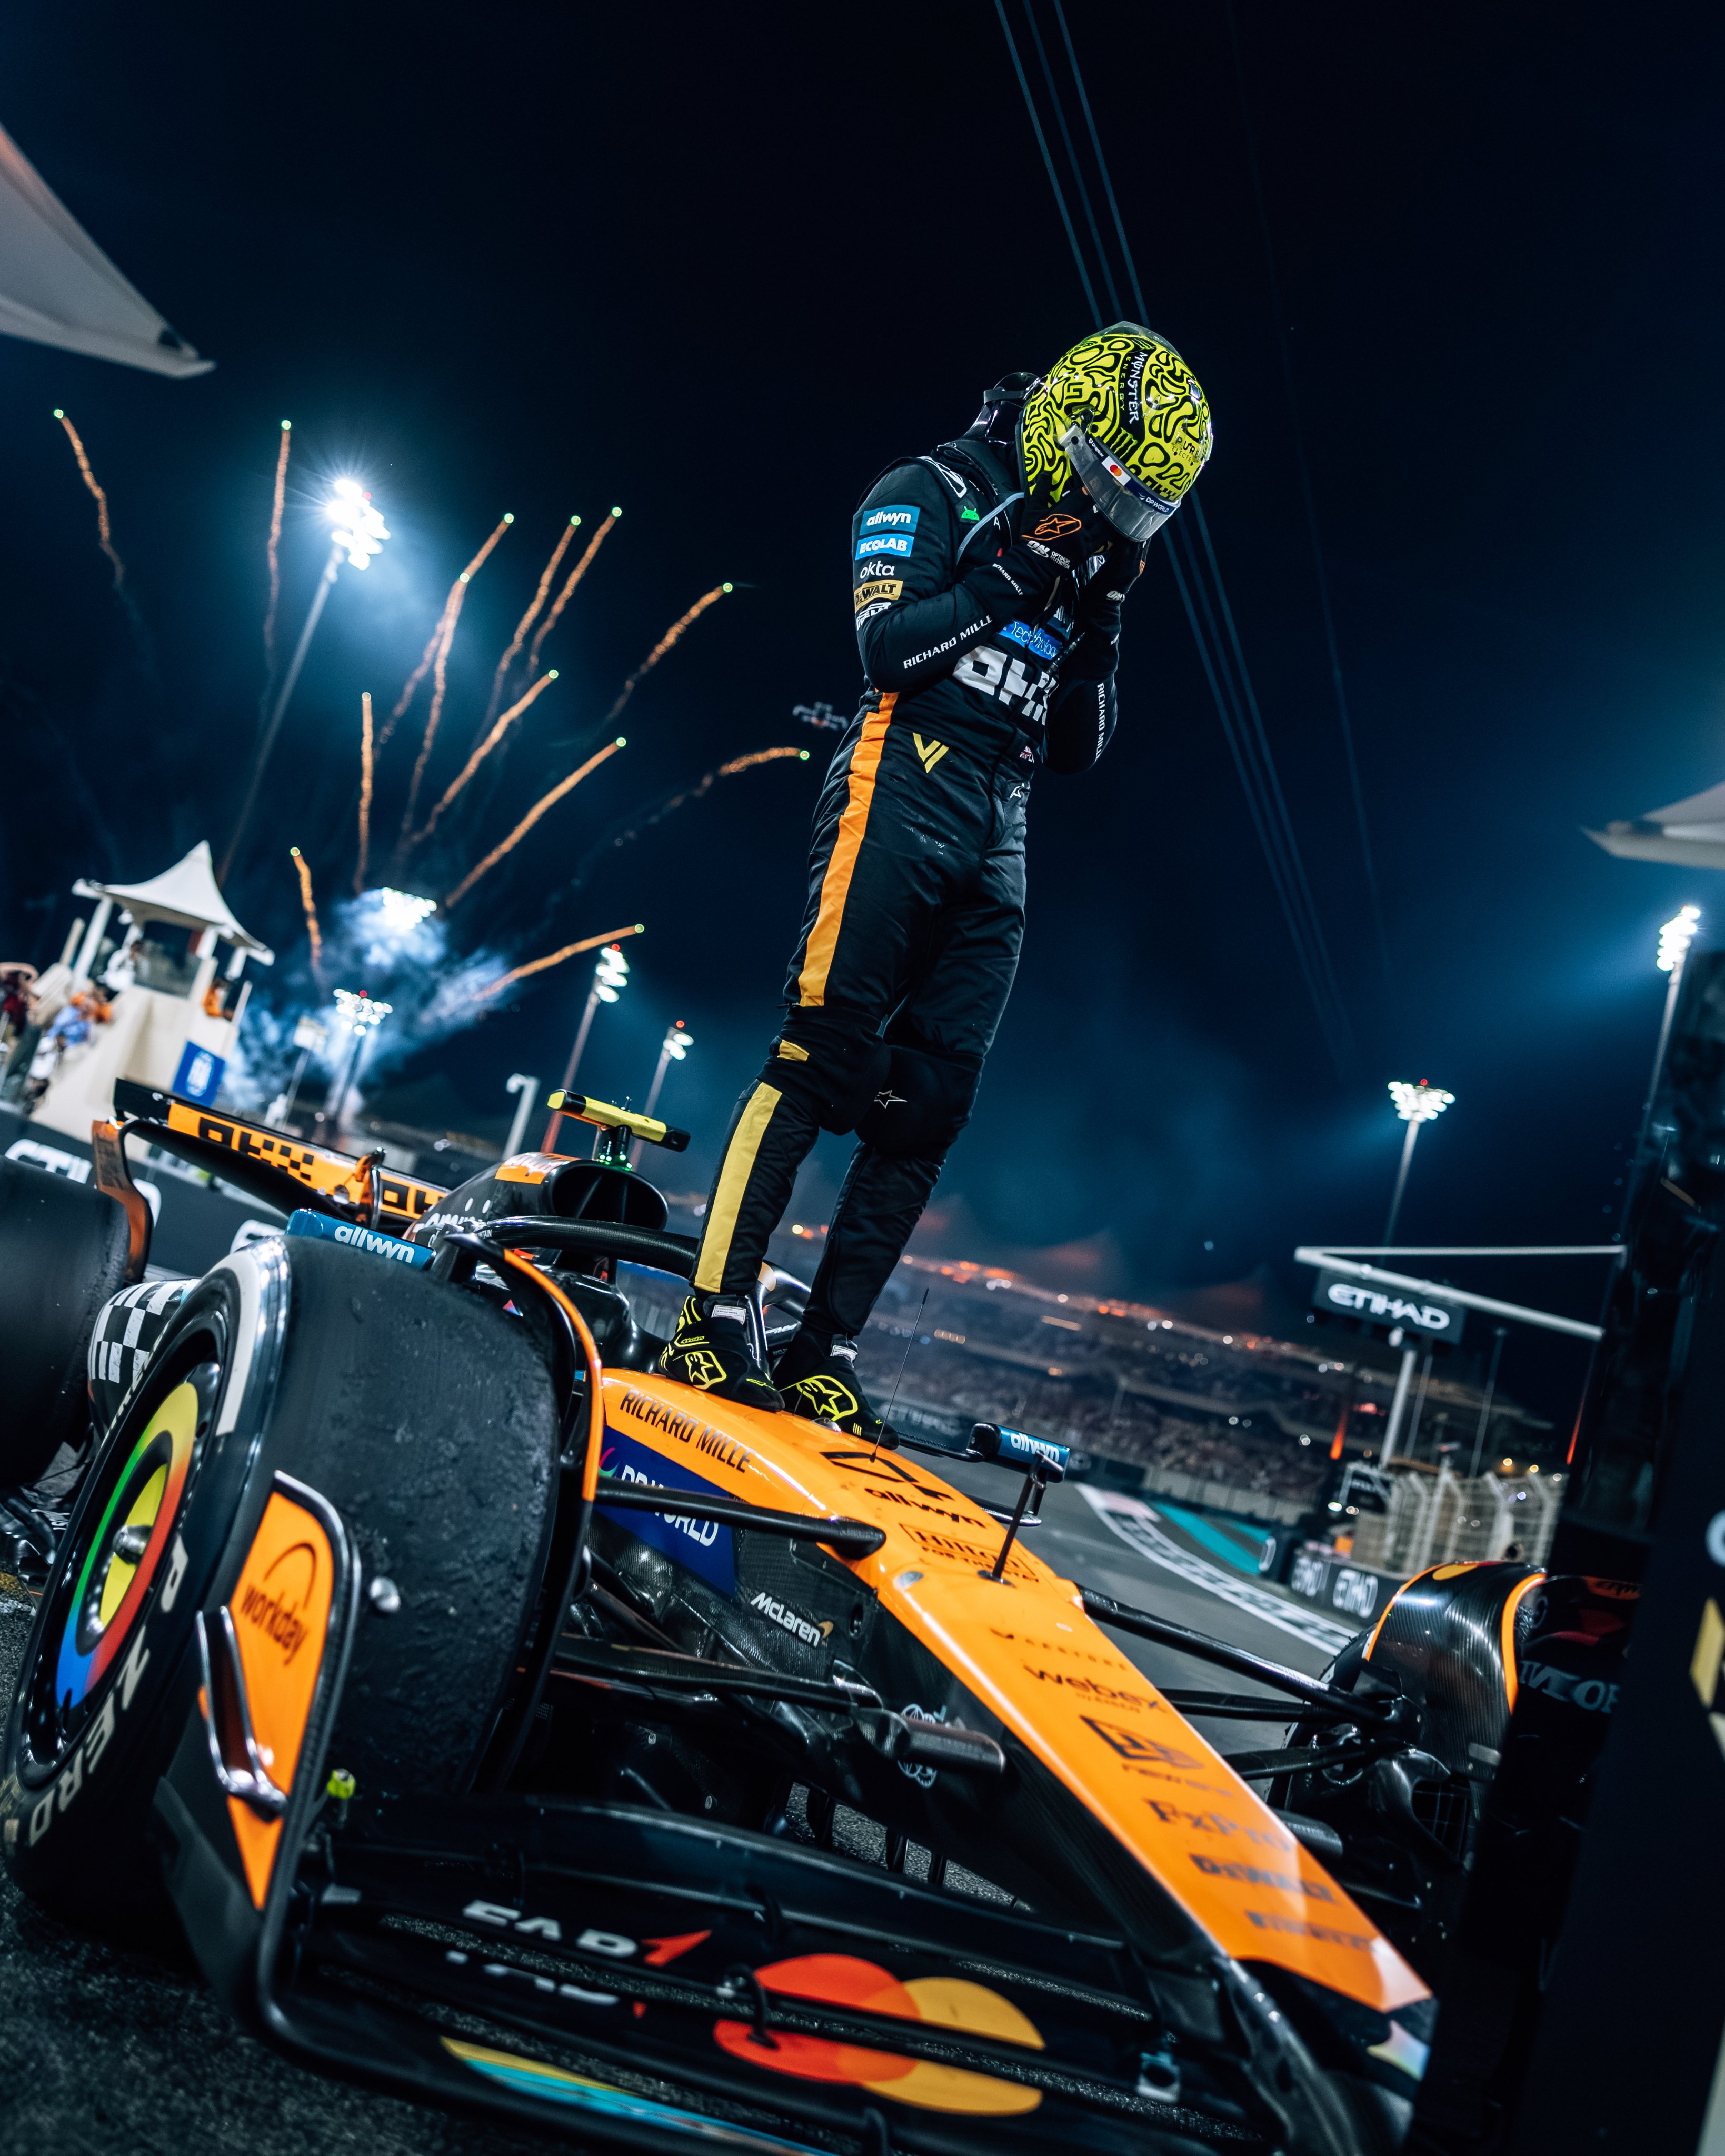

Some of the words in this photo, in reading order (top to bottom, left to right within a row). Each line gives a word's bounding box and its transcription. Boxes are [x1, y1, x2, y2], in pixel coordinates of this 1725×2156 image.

[1120, 356, 1131, 411] ENERGY
[1128, 352, 1148, 424] MONSTER
[1092, 442, 1104, 458] Dropbox
[866, 511, 912, 527] allwyn
[1153, 501, 1169, 513] WORLD
[859, 537, 908, 554] ECOLAB
[1050, 556, 1071, 570] NUTRITION
[1052, 551, 1071, 565] OPTIMUM
[860, 560, 895, 579] okta
[903, 637, 957, 669] RICHARD
[960, 615, 993, 641] MILLE
[1097, 682, 1105, 731] RICHARD
[1095, 732, 1104, 762] MILL
[334, 1223, 415, 1264] allwyn
[1327, 1283, 1451, 1330] ETIHAD
[620, 1389, 700, 1443] RICHARD
[695, 1424, 757, 1473] MILLE
[1010, 1432, 1060, 1463] allwyn
[864, 1488, 988, 1529] allwyn
[240, 1581, 311, 1666] workday
[750, 1592, 821, 1648] McLaren
